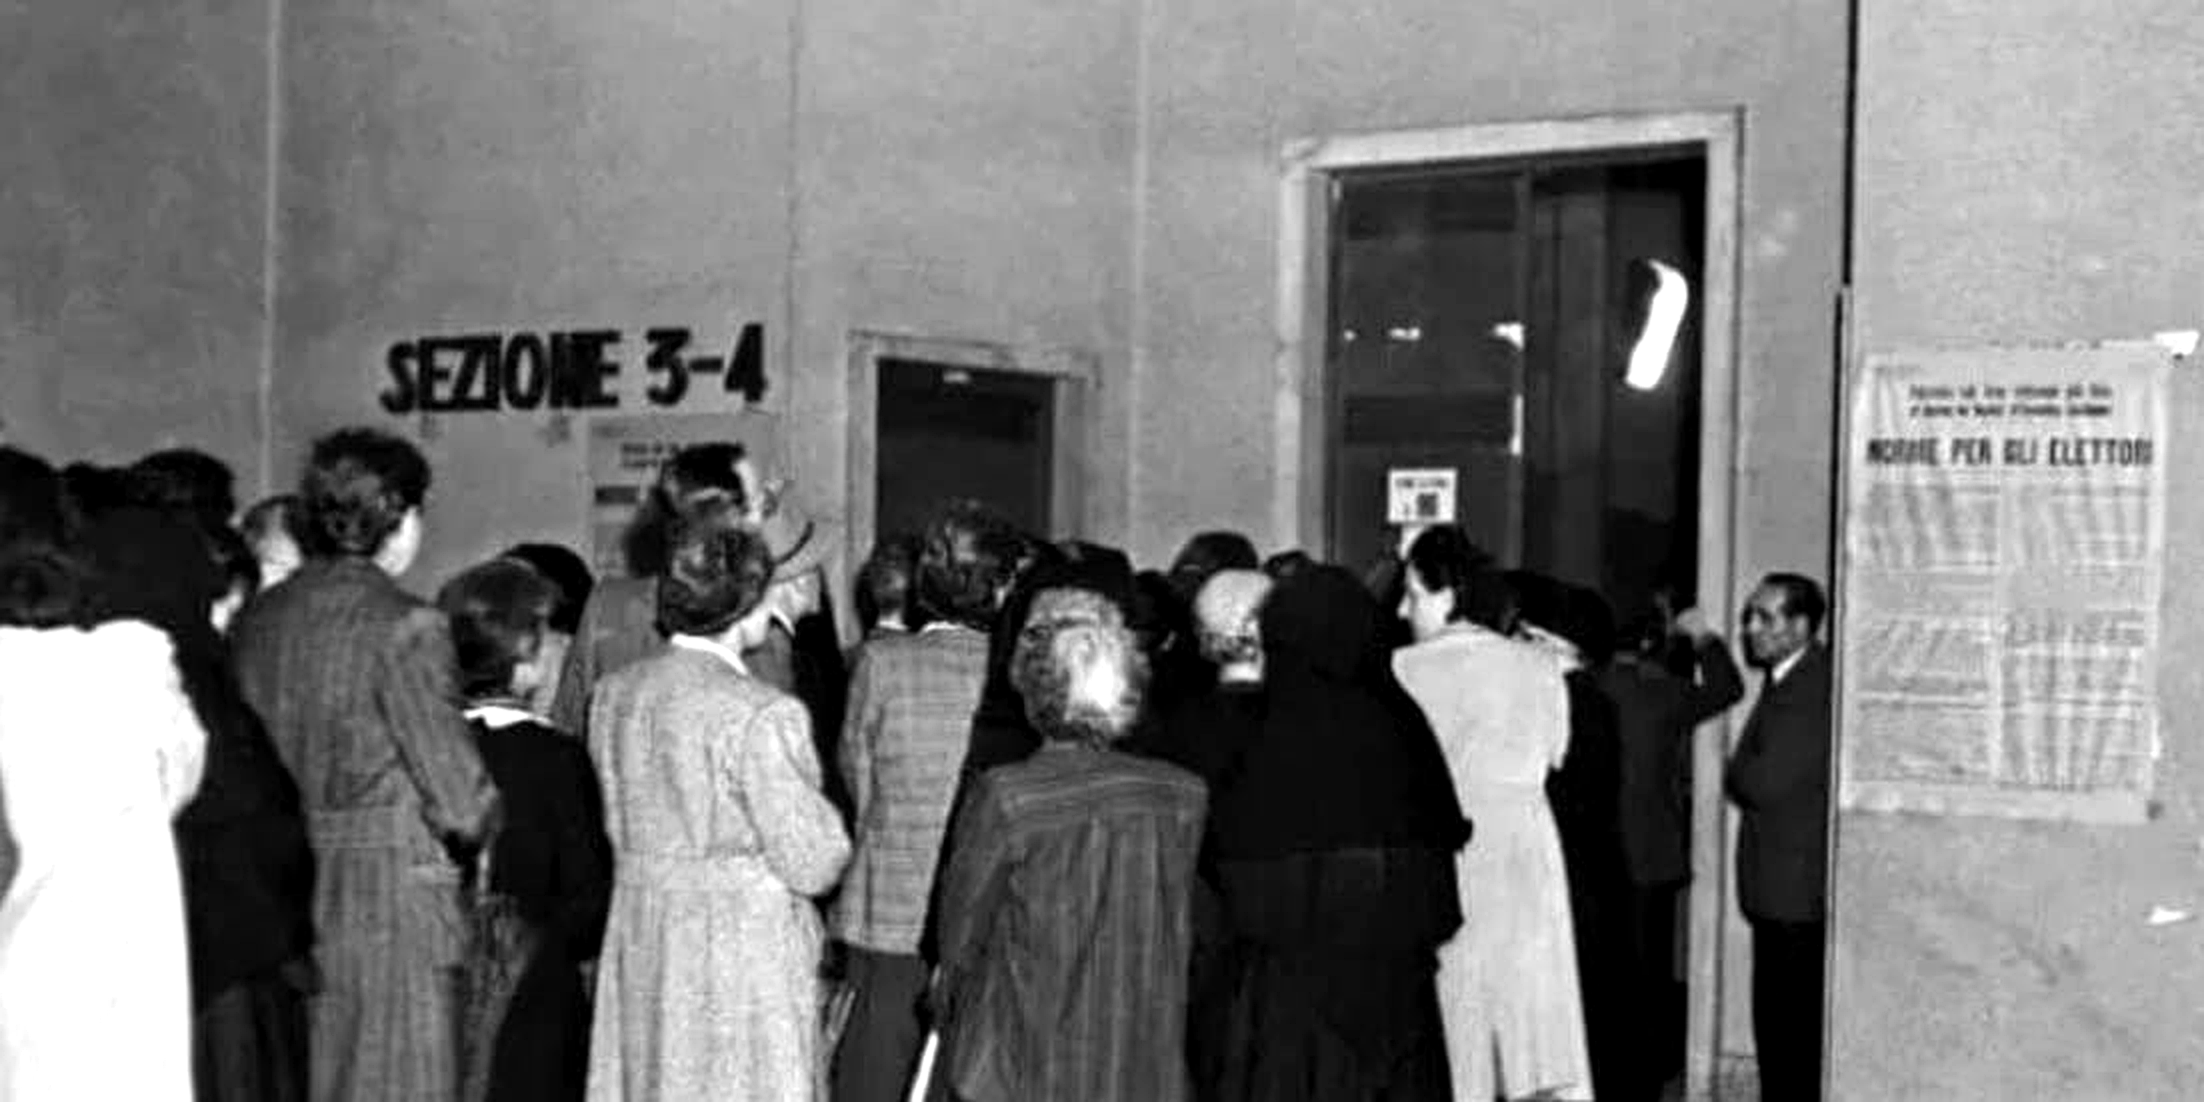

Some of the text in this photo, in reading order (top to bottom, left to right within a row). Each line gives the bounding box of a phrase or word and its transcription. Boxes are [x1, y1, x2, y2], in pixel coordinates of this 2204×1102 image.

[379, 323, 768, 414] SEZIONE 3-4
[1951, 437, 1992, 466] PER
[2003, 437, 2038, 466] GLI
[2049, 436, 2153, 466] ELETTORI
